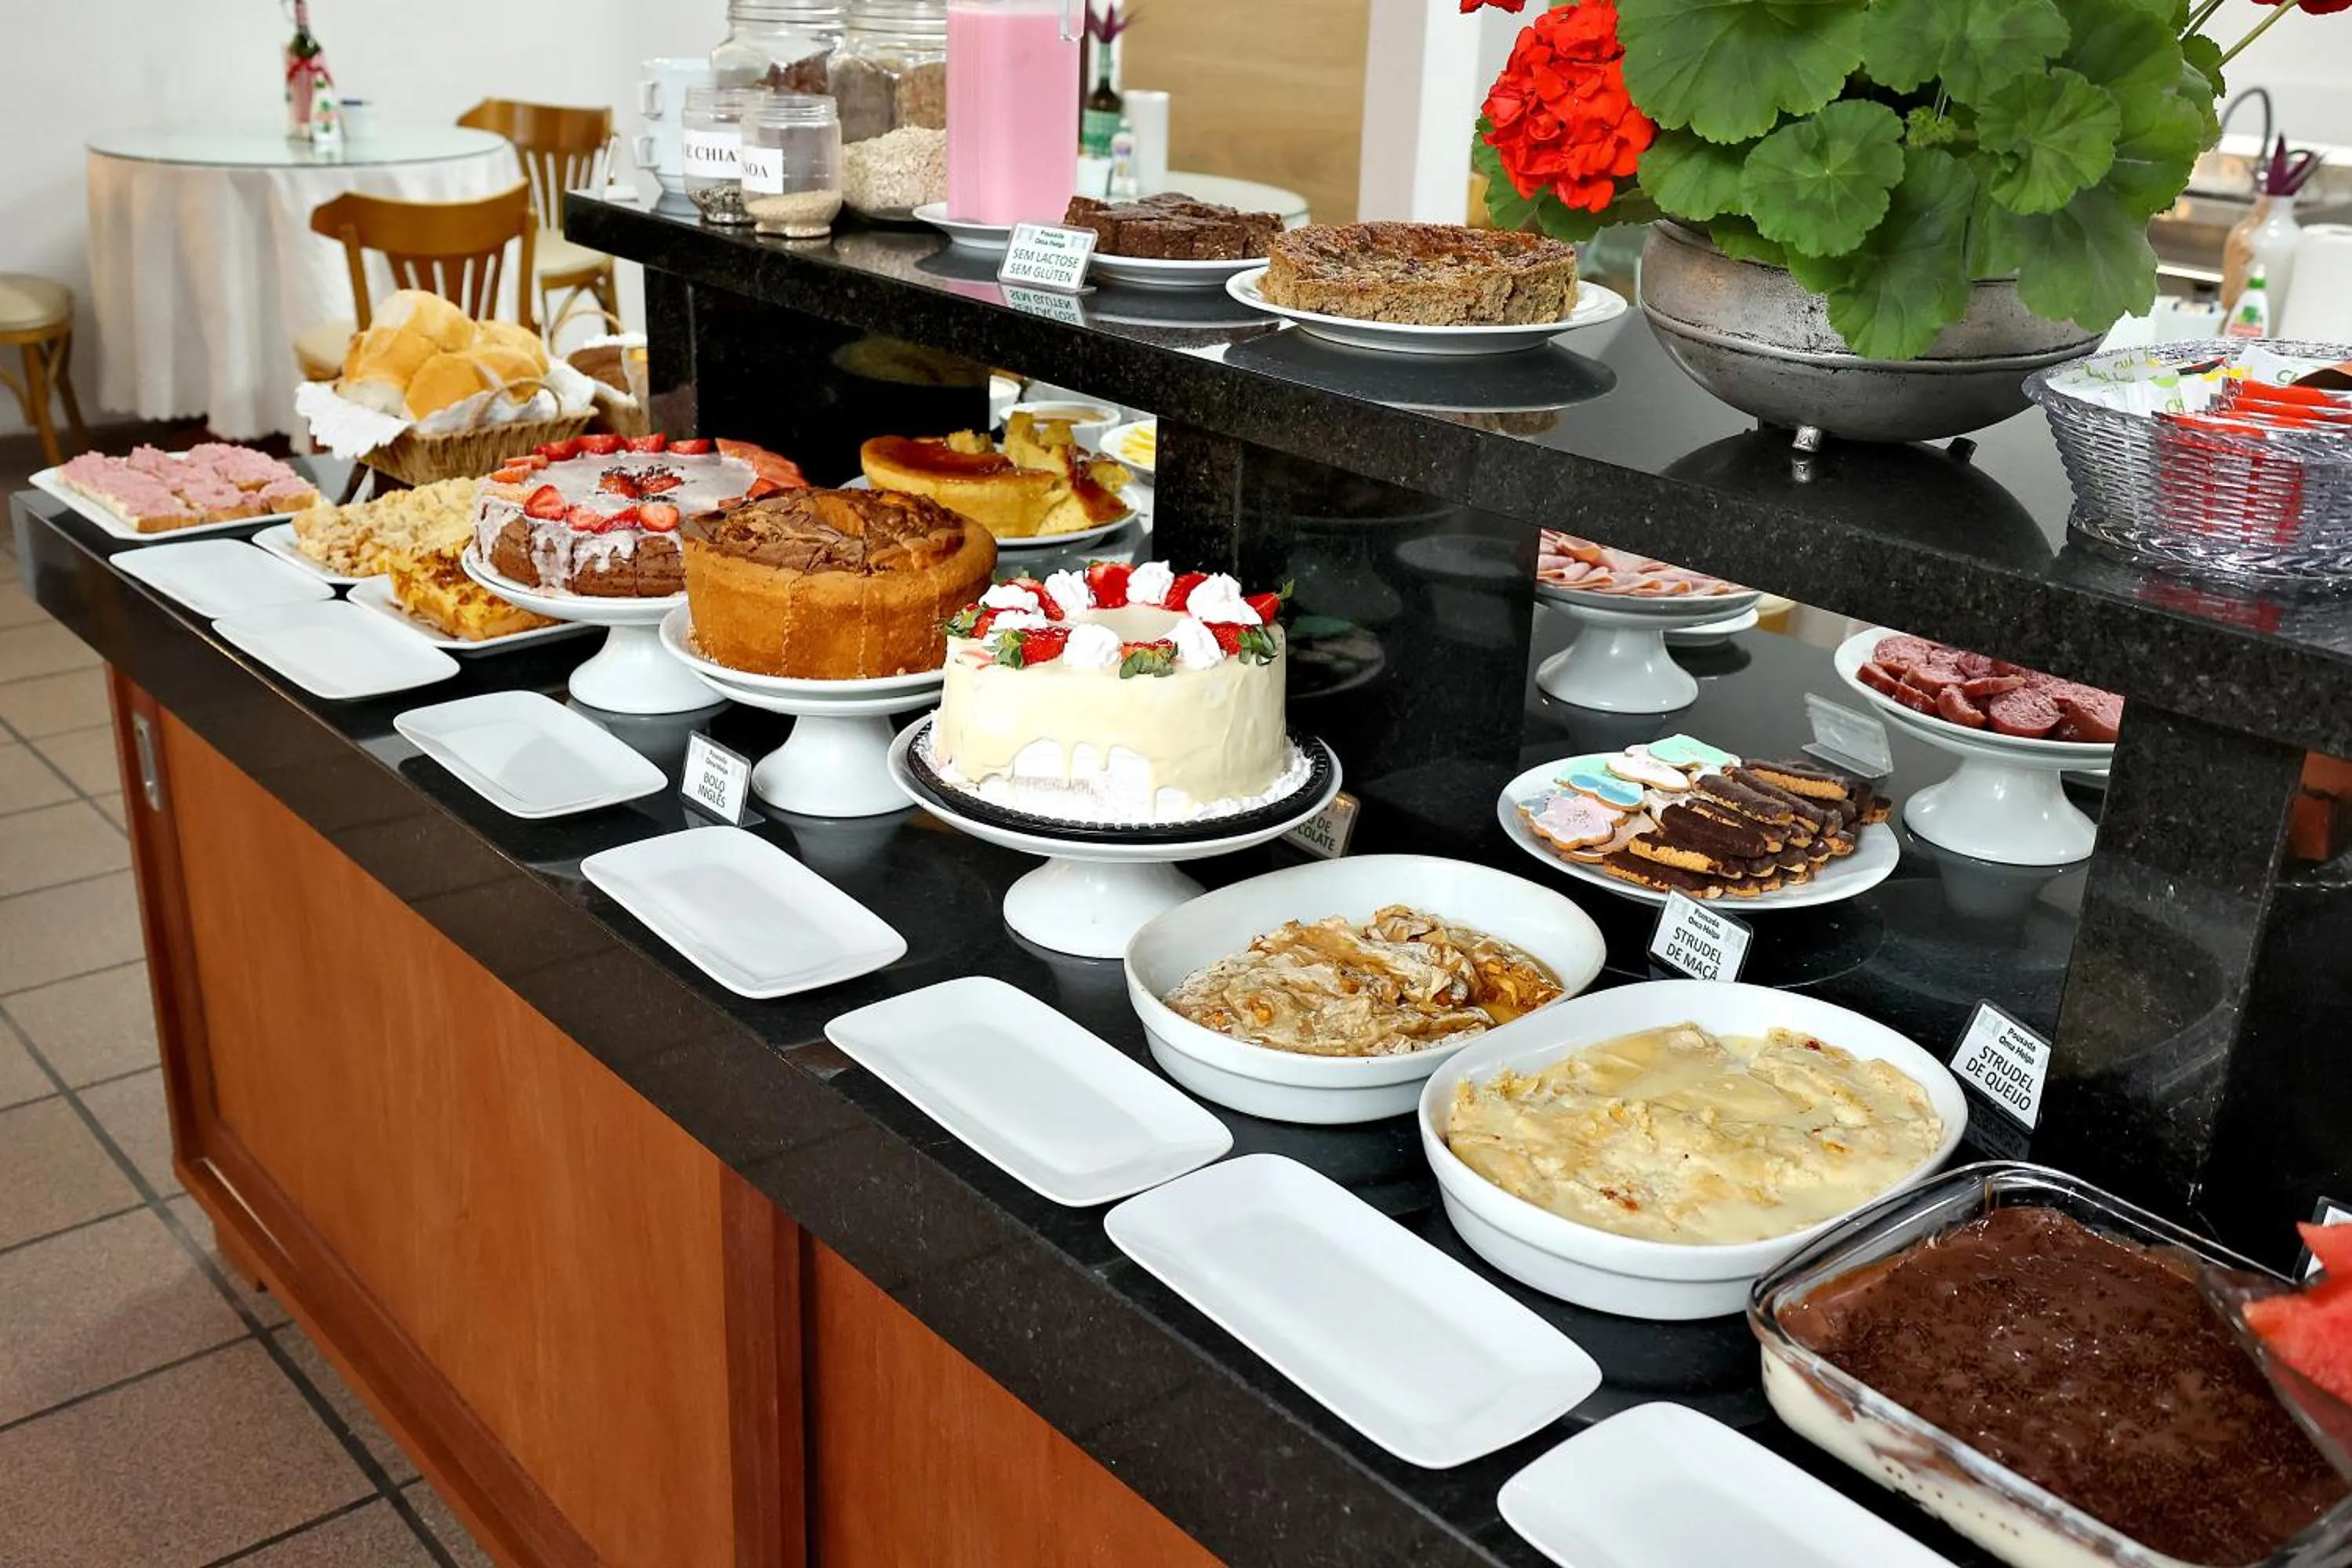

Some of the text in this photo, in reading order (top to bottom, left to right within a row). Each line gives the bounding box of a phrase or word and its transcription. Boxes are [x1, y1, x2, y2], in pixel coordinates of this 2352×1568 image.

[695, 146, 737, 162] CHIA
[1010, 263, 1032, 278] SEM
[1013, 248, 1080, 269] SEM LACTOSE
[703, 771, 725, 792] BOLO
[1293, 823, 1336, 851] COLATE
[1317, 817, 1332, 834] DE
[1673, 926, 1722, 966] STRUDEL
[1666, 942, 1719, 982] DE MAÇÃ
[1979, 1045, 2034, 1094] STRUDEL
[1965, 1057, 2032, 1112] DE QUEIJO
